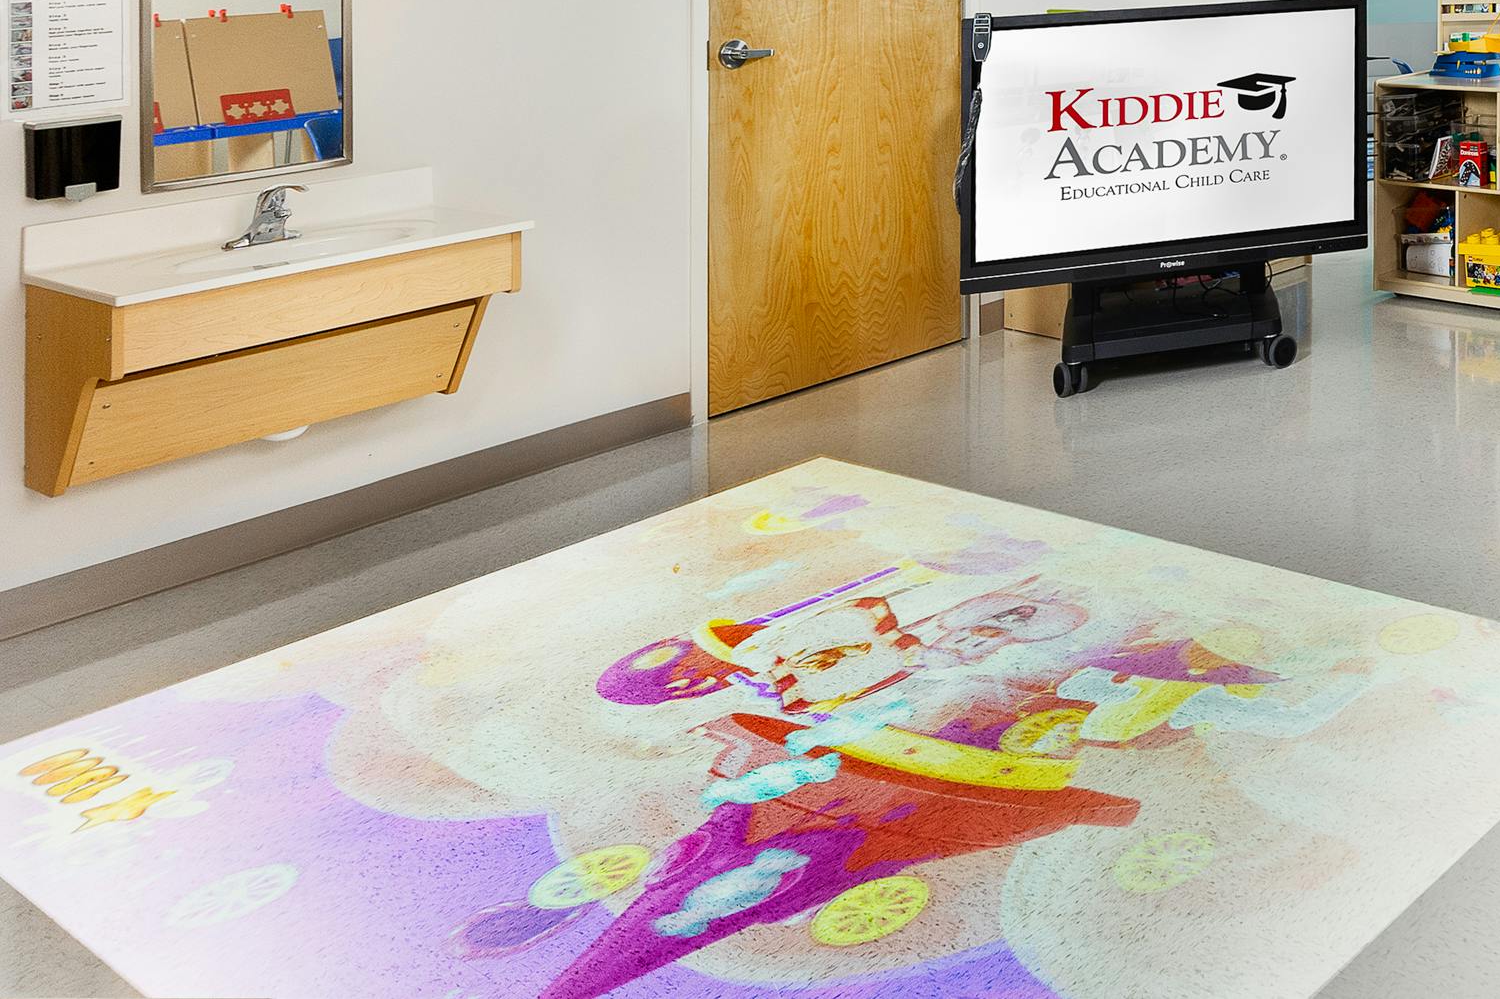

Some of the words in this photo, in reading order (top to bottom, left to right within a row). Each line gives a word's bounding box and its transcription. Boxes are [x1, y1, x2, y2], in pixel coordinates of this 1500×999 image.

[1045, 88, 1225, 133] KIDDIE
[1044, 130, 1281, 180] ACADEMY
[1060, 180, 1170, 201] EDUCATIONAL
[1175, 174, 1224, 189] CHILD
[1229, 169, 1271, 184] CARE
